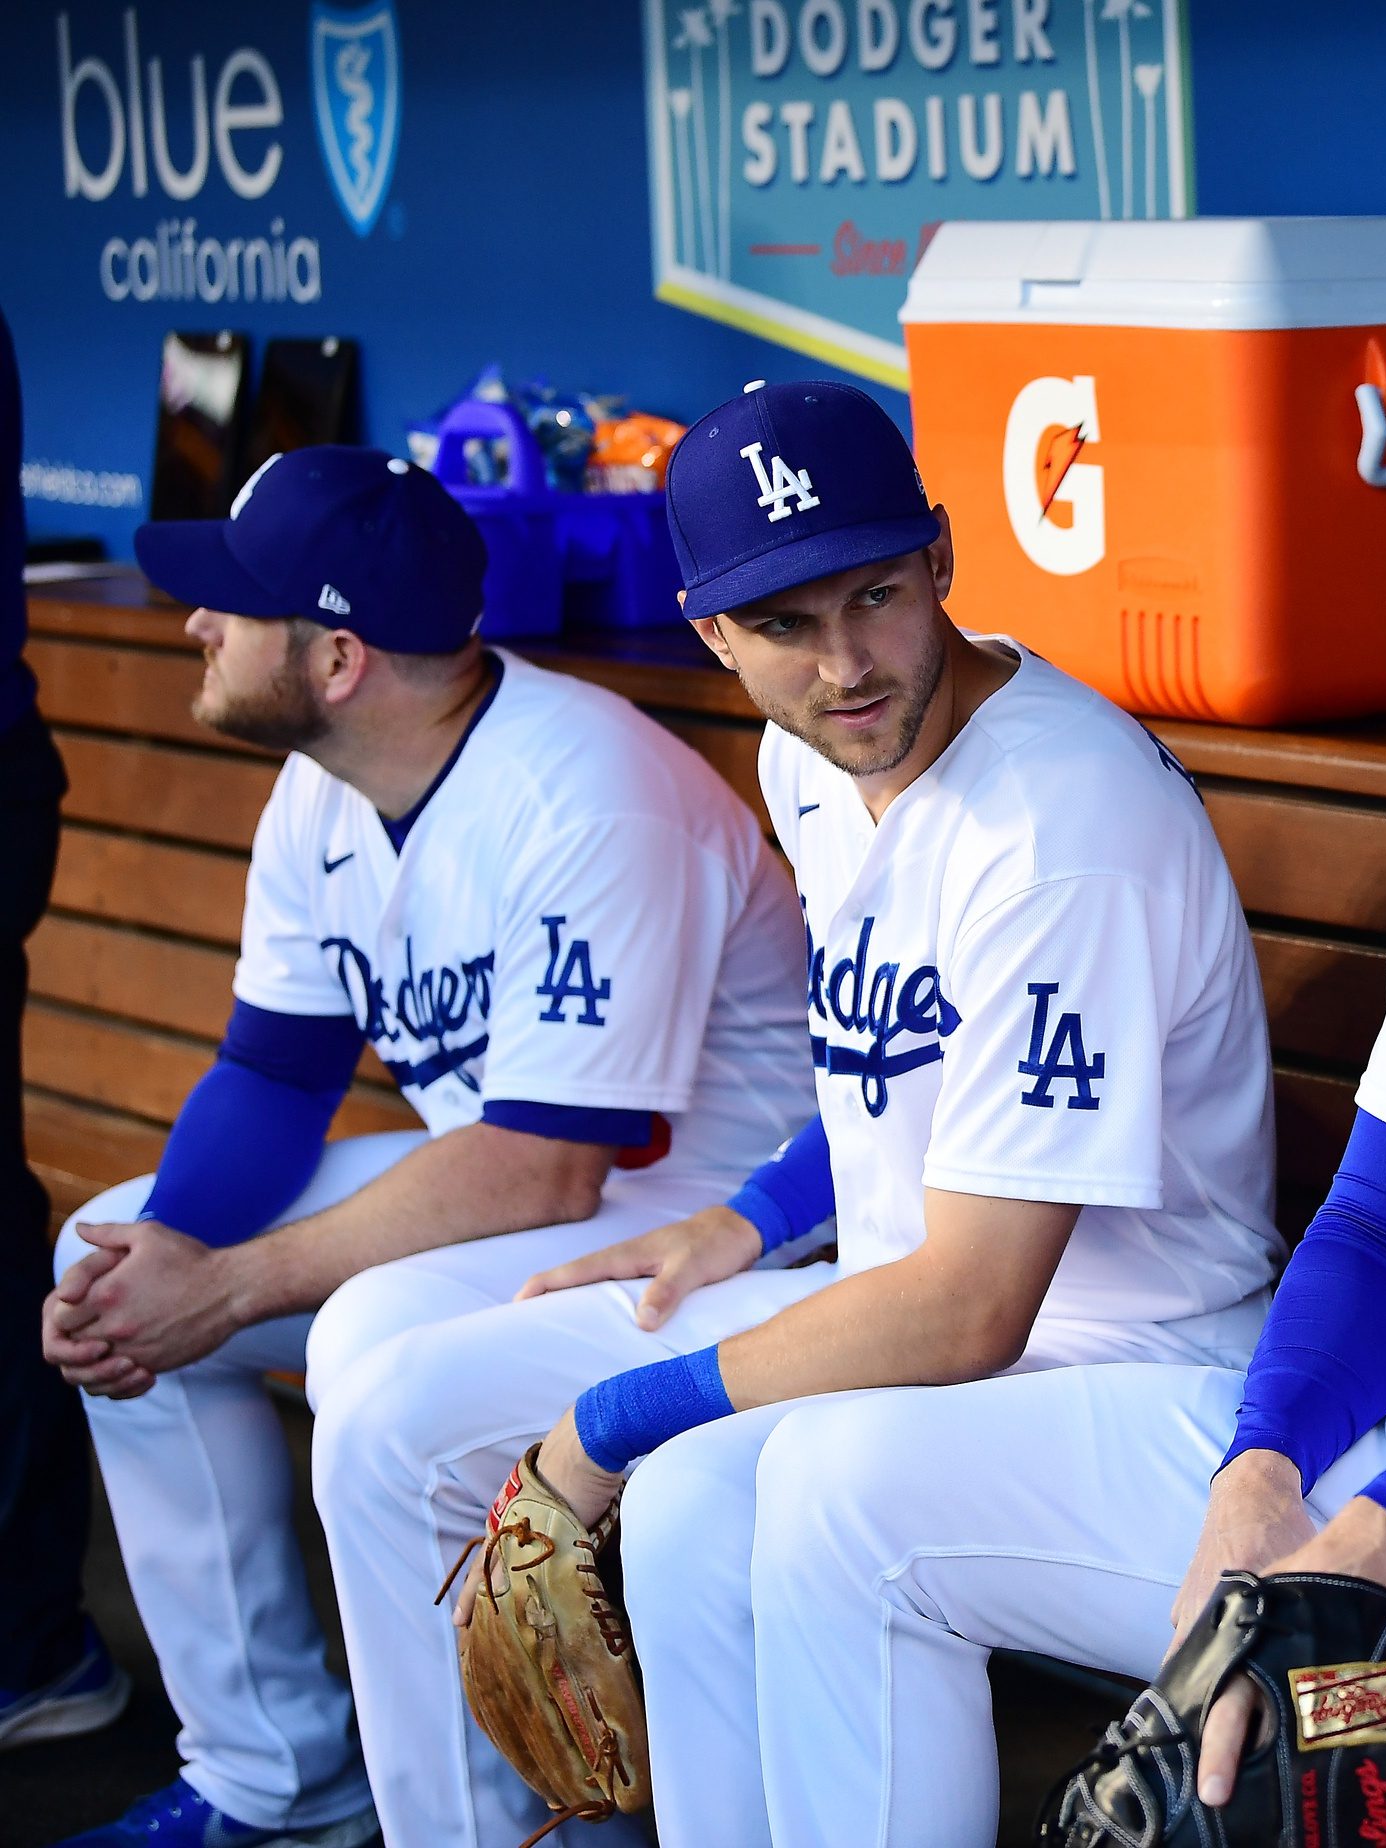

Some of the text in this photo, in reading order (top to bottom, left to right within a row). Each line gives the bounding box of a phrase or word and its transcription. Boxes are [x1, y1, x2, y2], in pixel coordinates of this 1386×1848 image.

[750, 0, 1056, 77] DODGER
[58, 9, 284, 201] blue
[742, 89, 1077, 186] STADIUM
[101, 217, 322, 302] california
[740, 441, 821, 523] LA
[1003, 376, 1106, 576] G
[536, 915, 611, 1026] LA
[1018, 981, 1105, 1110] LA
